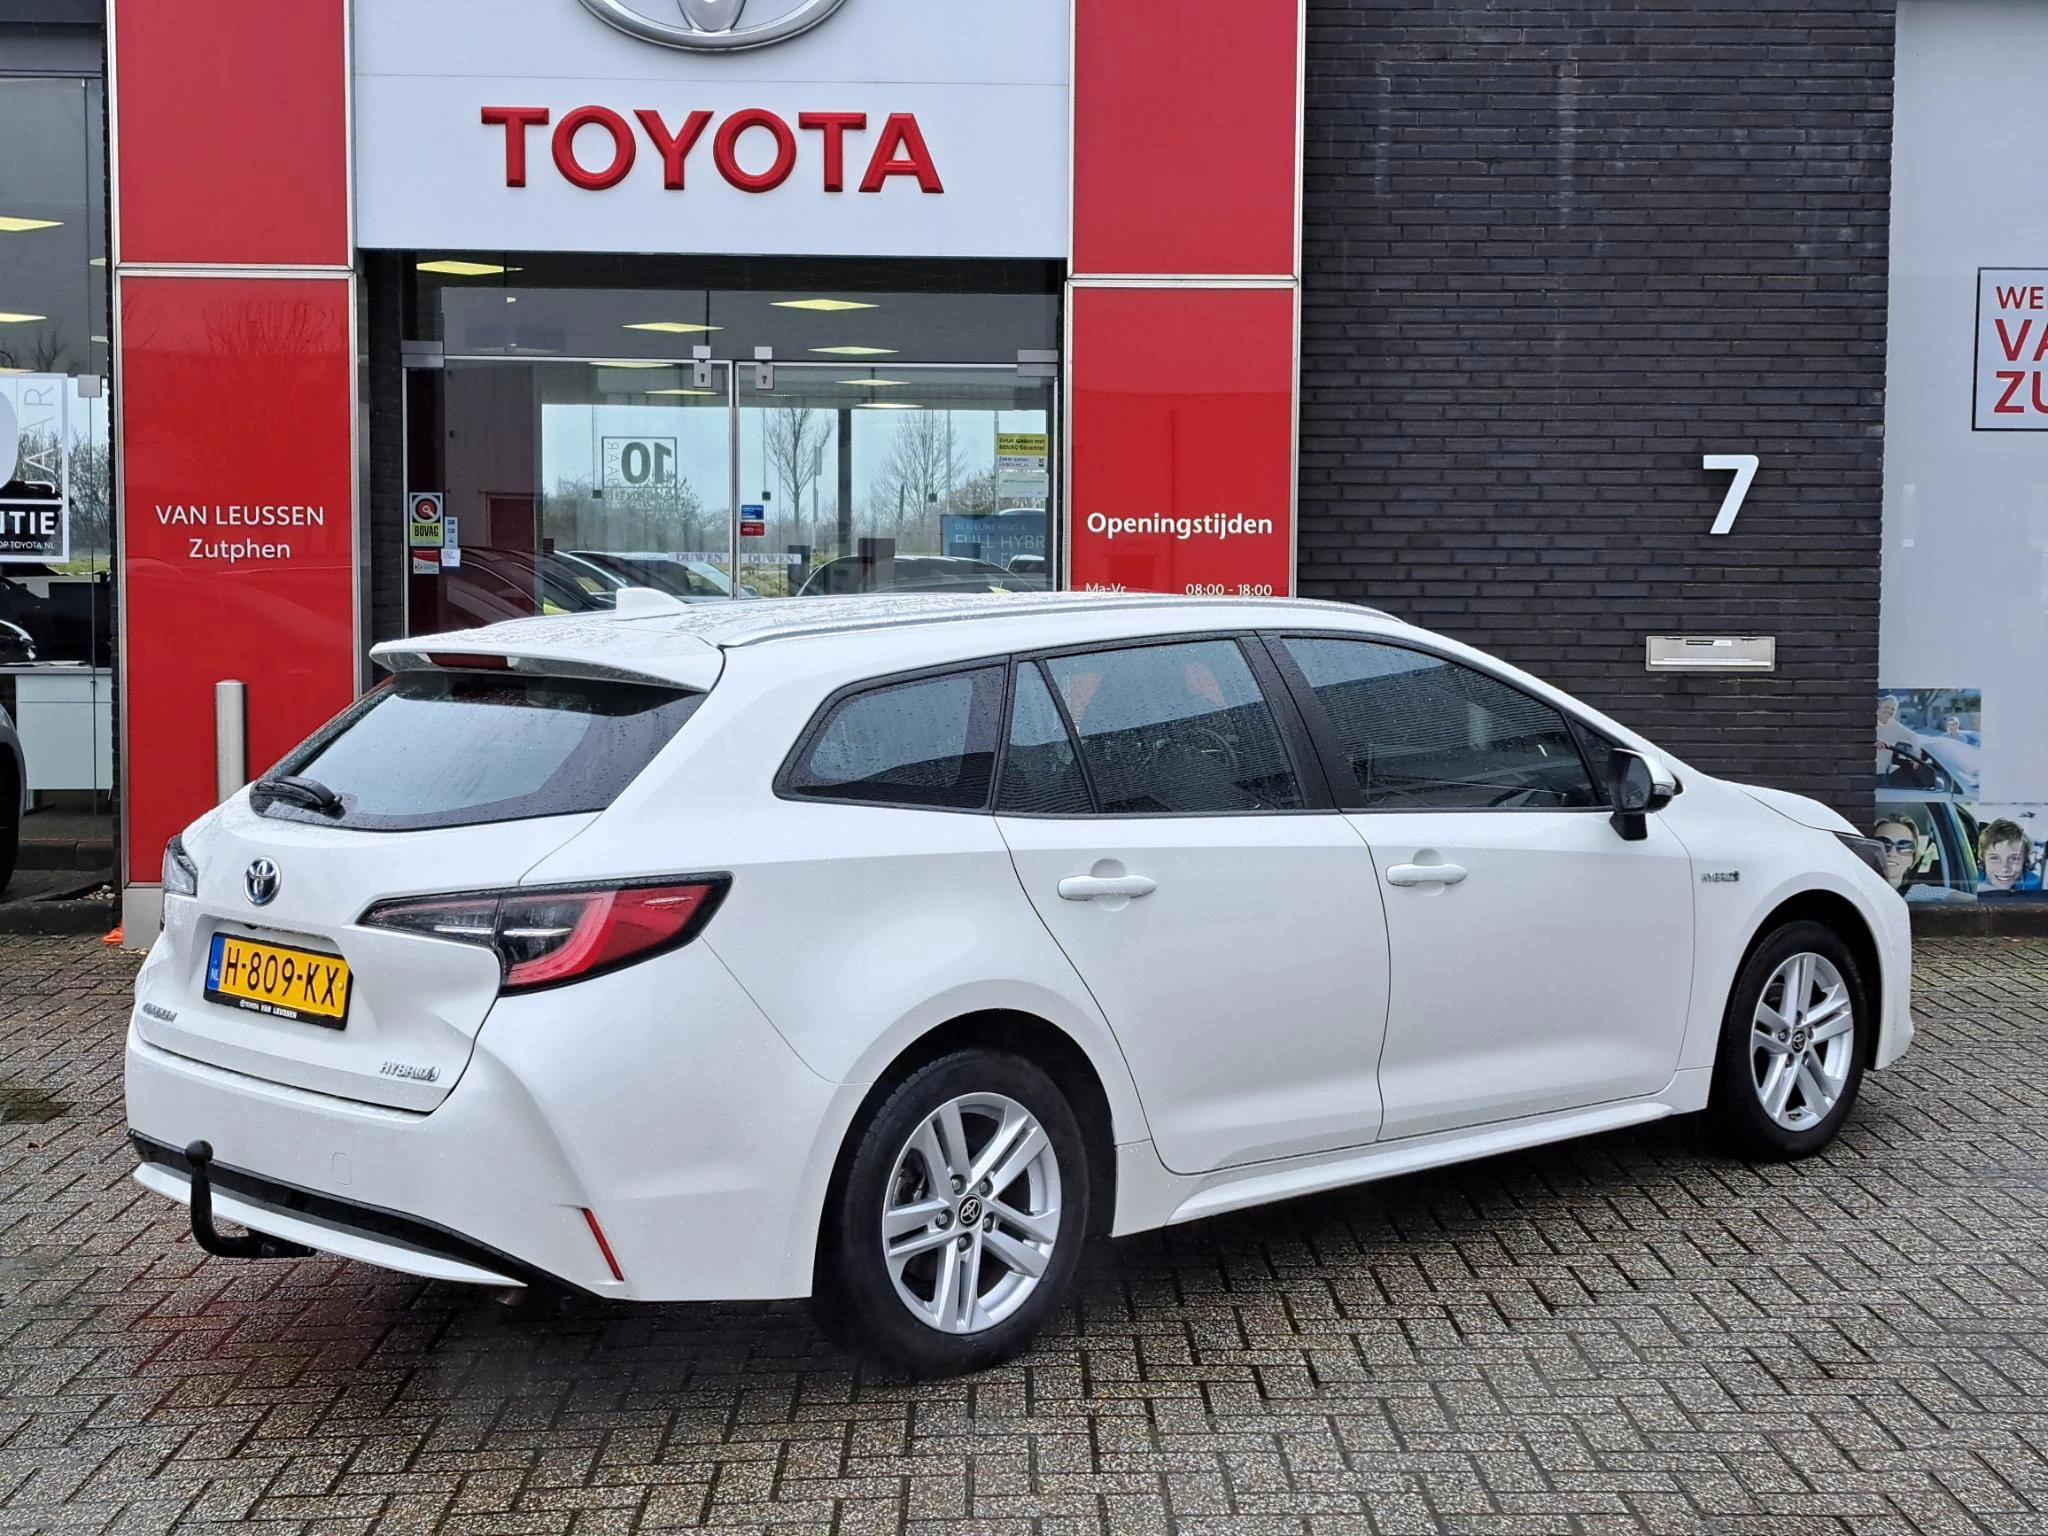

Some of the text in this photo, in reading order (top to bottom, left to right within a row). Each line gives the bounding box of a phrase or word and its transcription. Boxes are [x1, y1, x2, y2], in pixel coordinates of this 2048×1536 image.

[481, 105, 944, 193] TOYOTA
[1996, 286, 2048, 309] WE
[1703, 455, 1759, 534] 7
[0, 511, 55, 535] TIE
[156, 505, 324, 526] VAN LEUSSEN
[1087, 512, 1272, 540] Openingstijden
[414, 526, 439, 537] BOVAG
[189, 538, 291, 563] Zutphen
[1185, 584, 1225, 596] 08:00
[1238, 584, 1273, 596] 18:00
[224, 946, 340, 1008] H-809-KX
